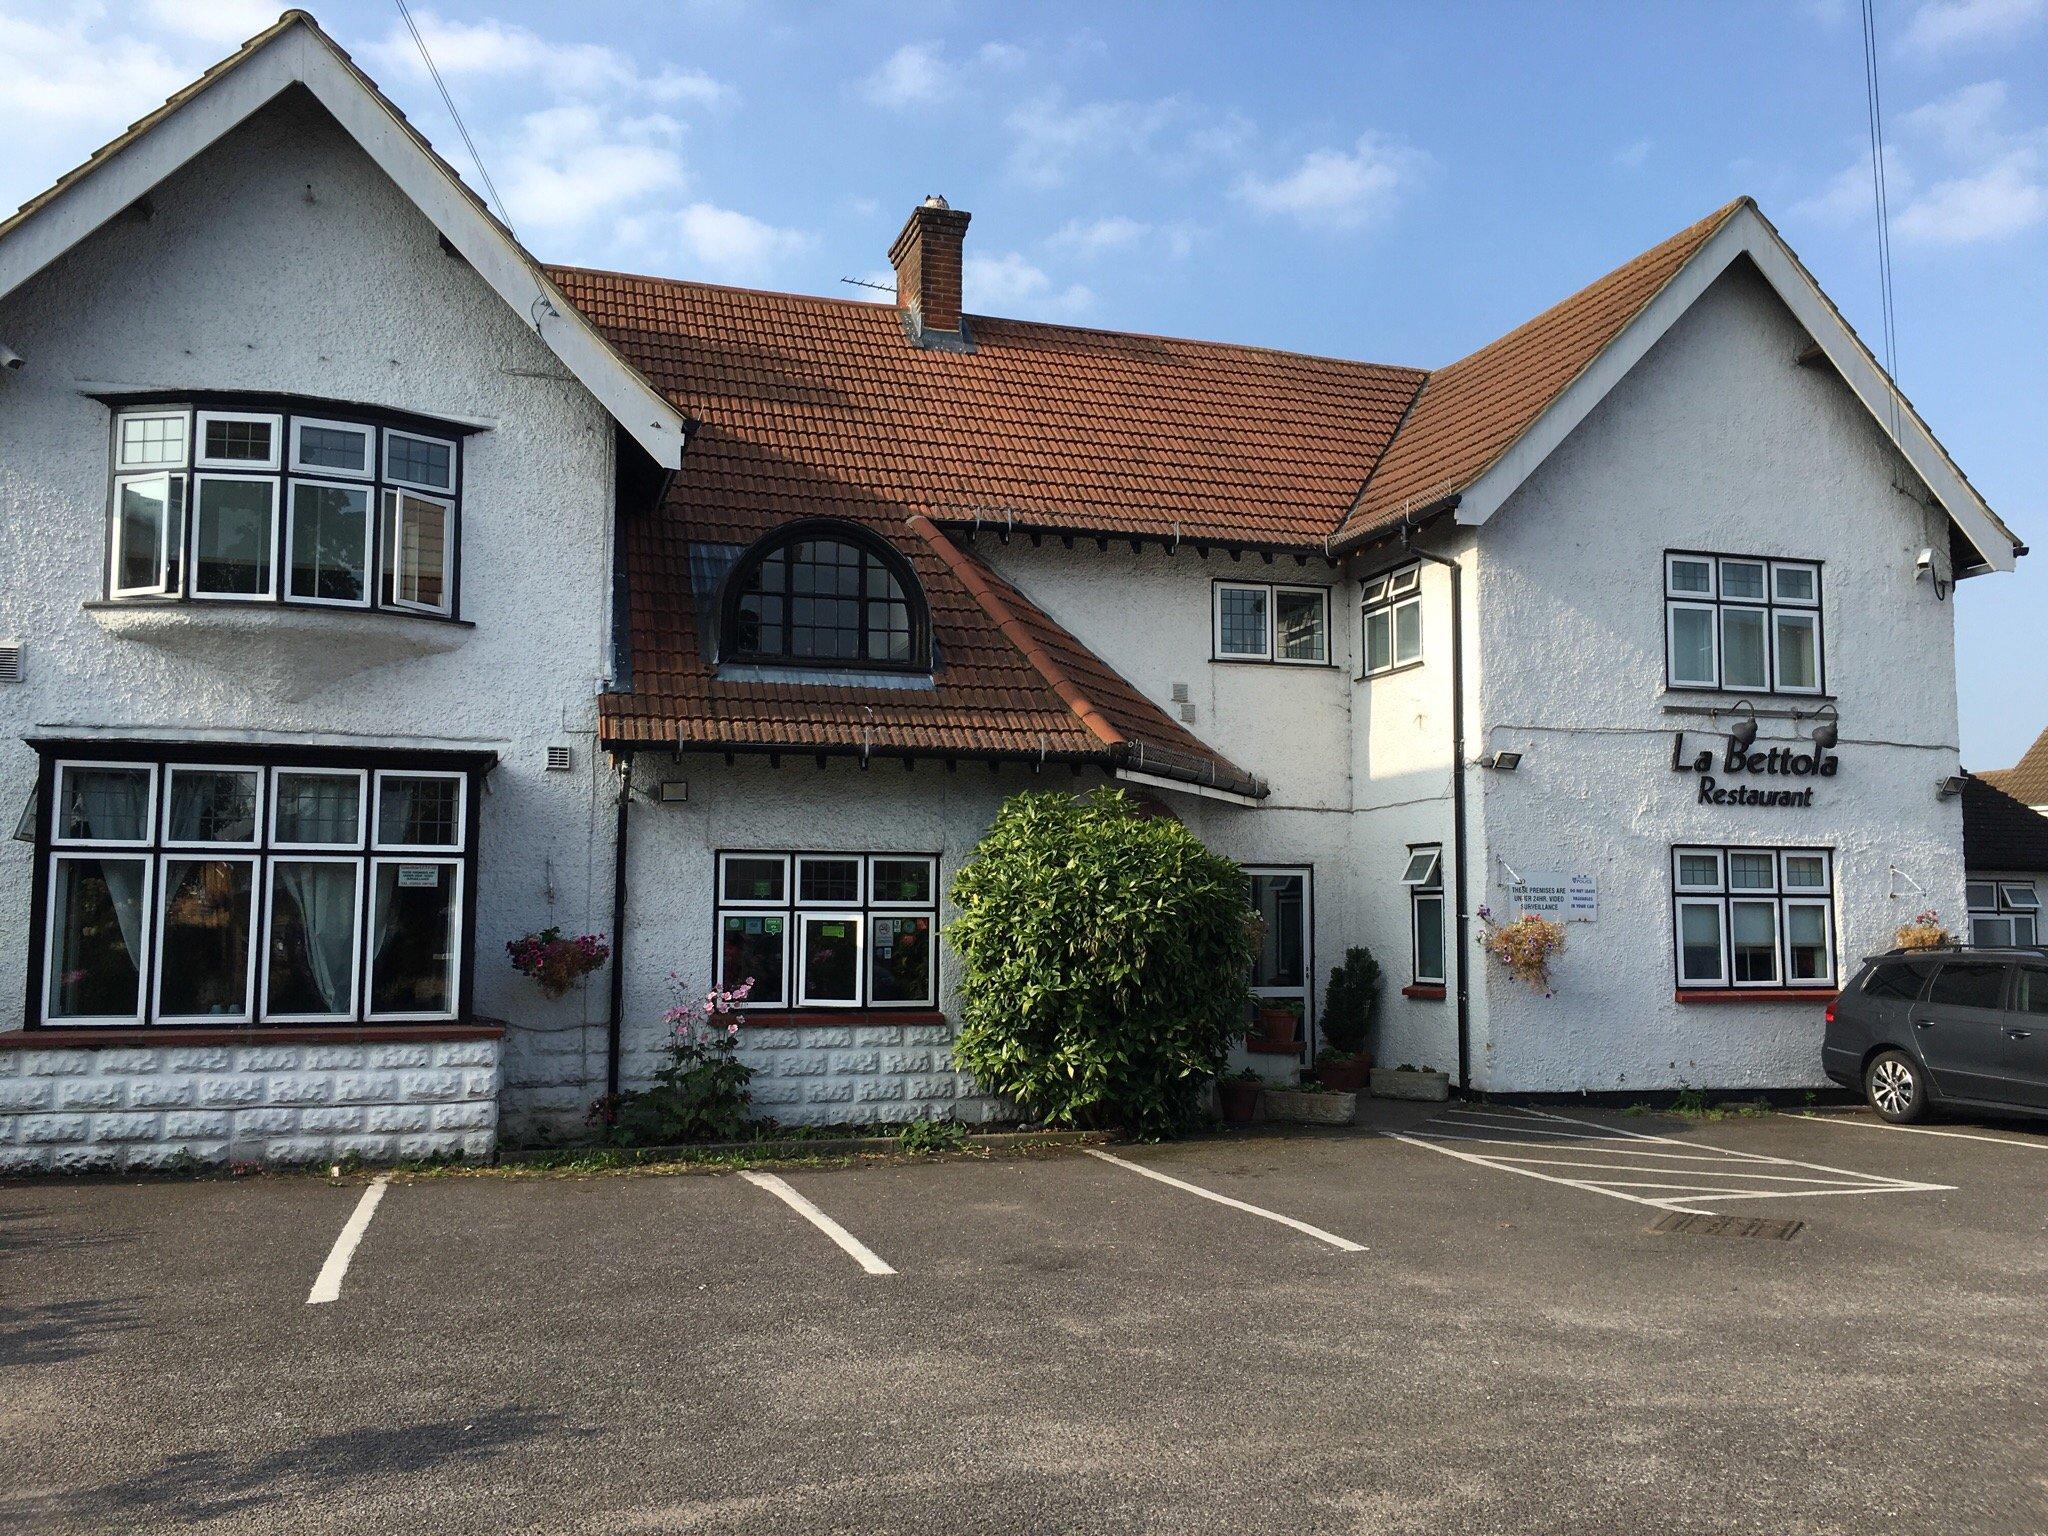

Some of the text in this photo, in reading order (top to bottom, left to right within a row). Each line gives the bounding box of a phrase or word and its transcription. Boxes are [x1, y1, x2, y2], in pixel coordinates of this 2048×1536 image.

[1671, 732, 1839, 777] La Bettola
[1697, 775, 1814, 808] Restaurant
